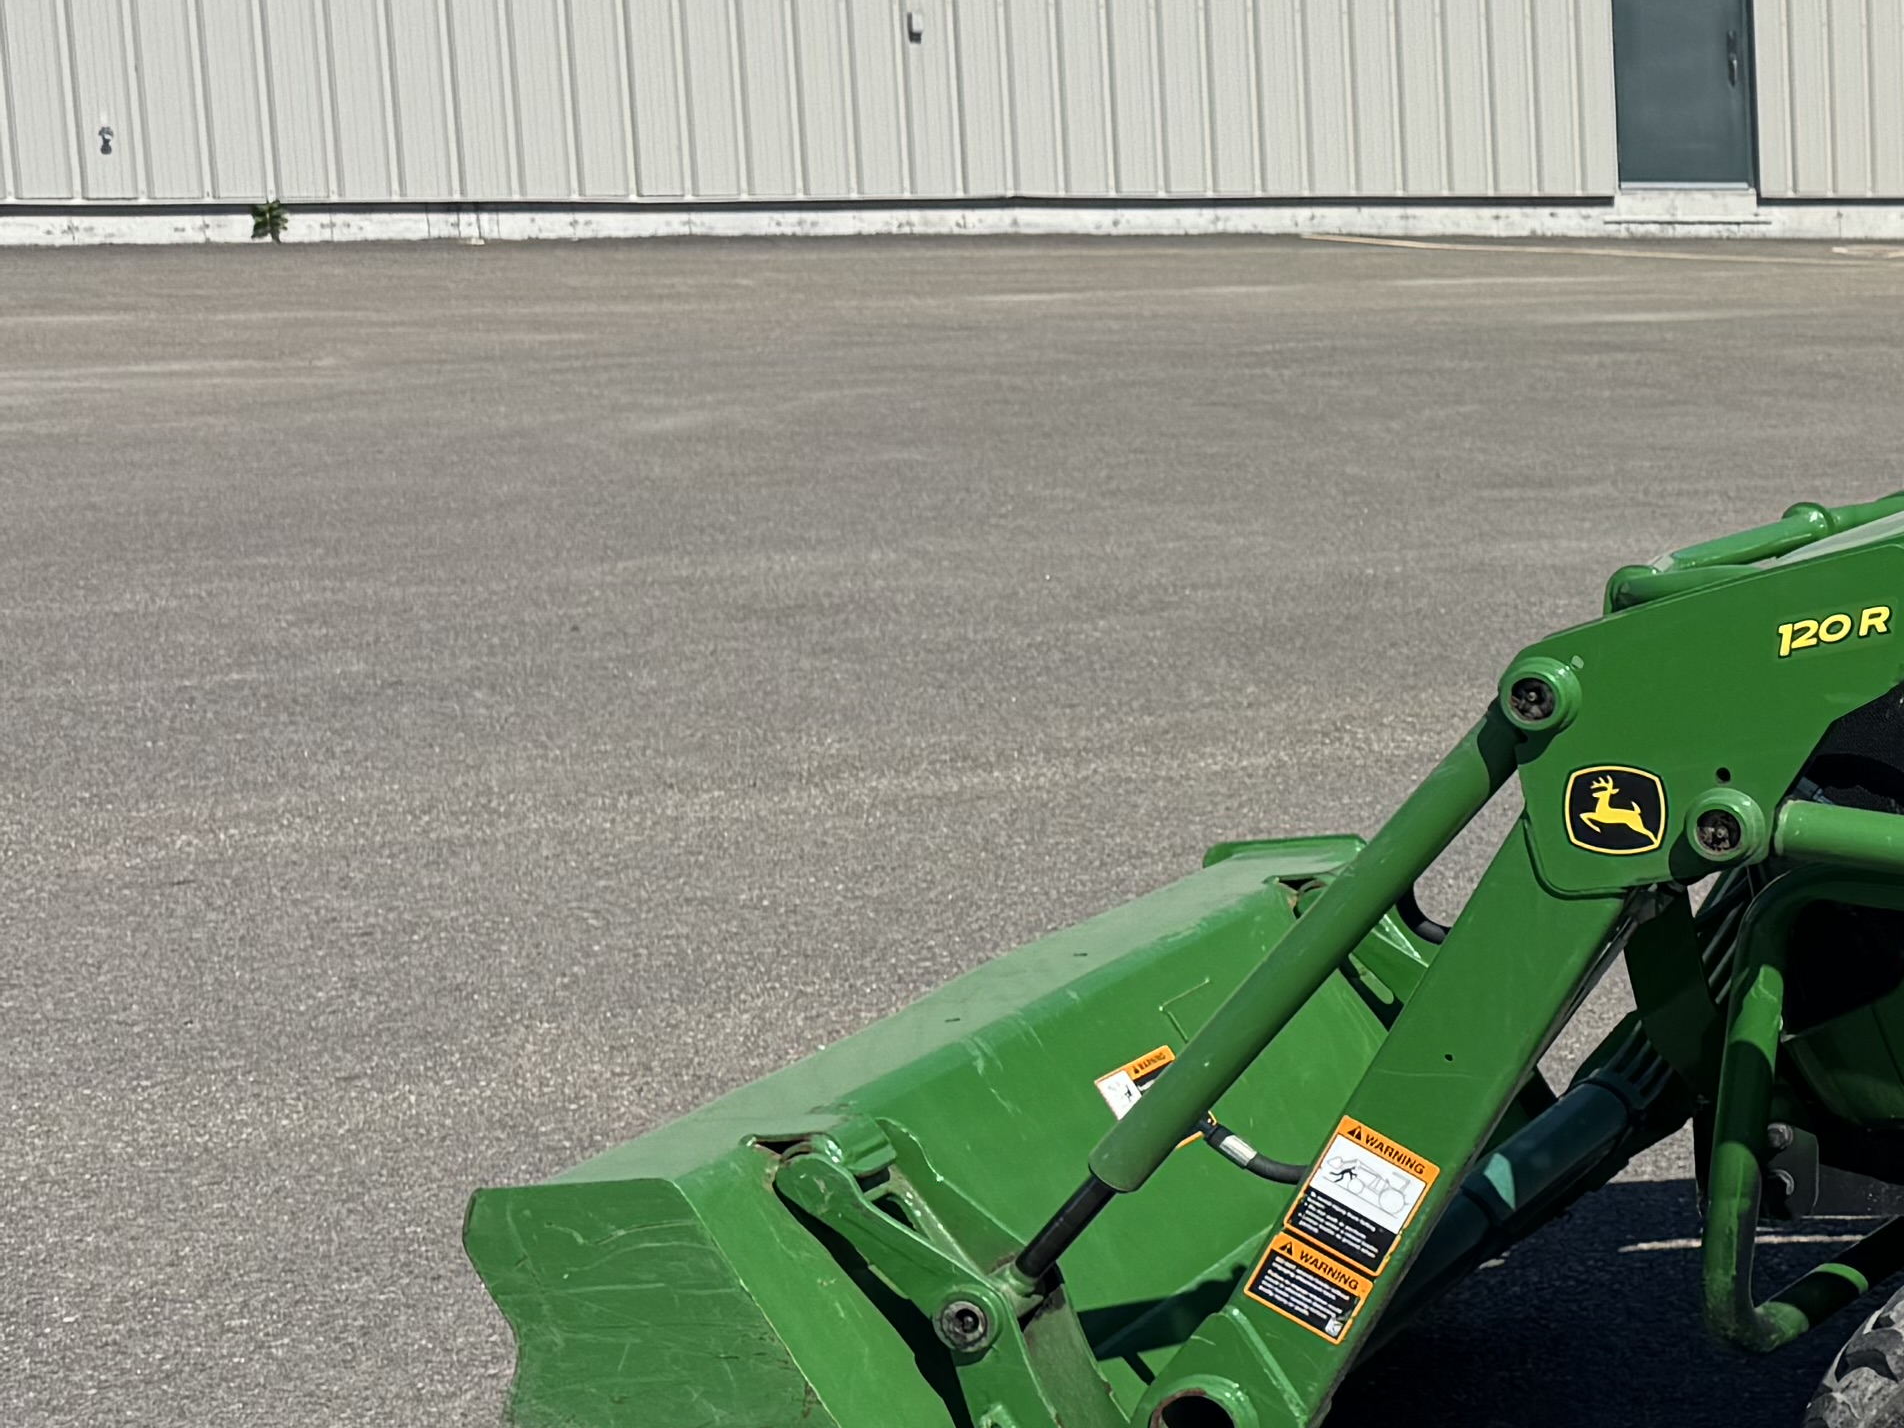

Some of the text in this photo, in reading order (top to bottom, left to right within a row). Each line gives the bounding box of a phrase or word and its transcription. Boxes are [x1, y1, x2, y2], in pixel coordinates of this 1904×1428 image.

[1777, 605, 1892, 659] 120 R
[1364, 1133, 1426, 1176] WARNING
[1299, 1250, 1359, 1291] WARNING
